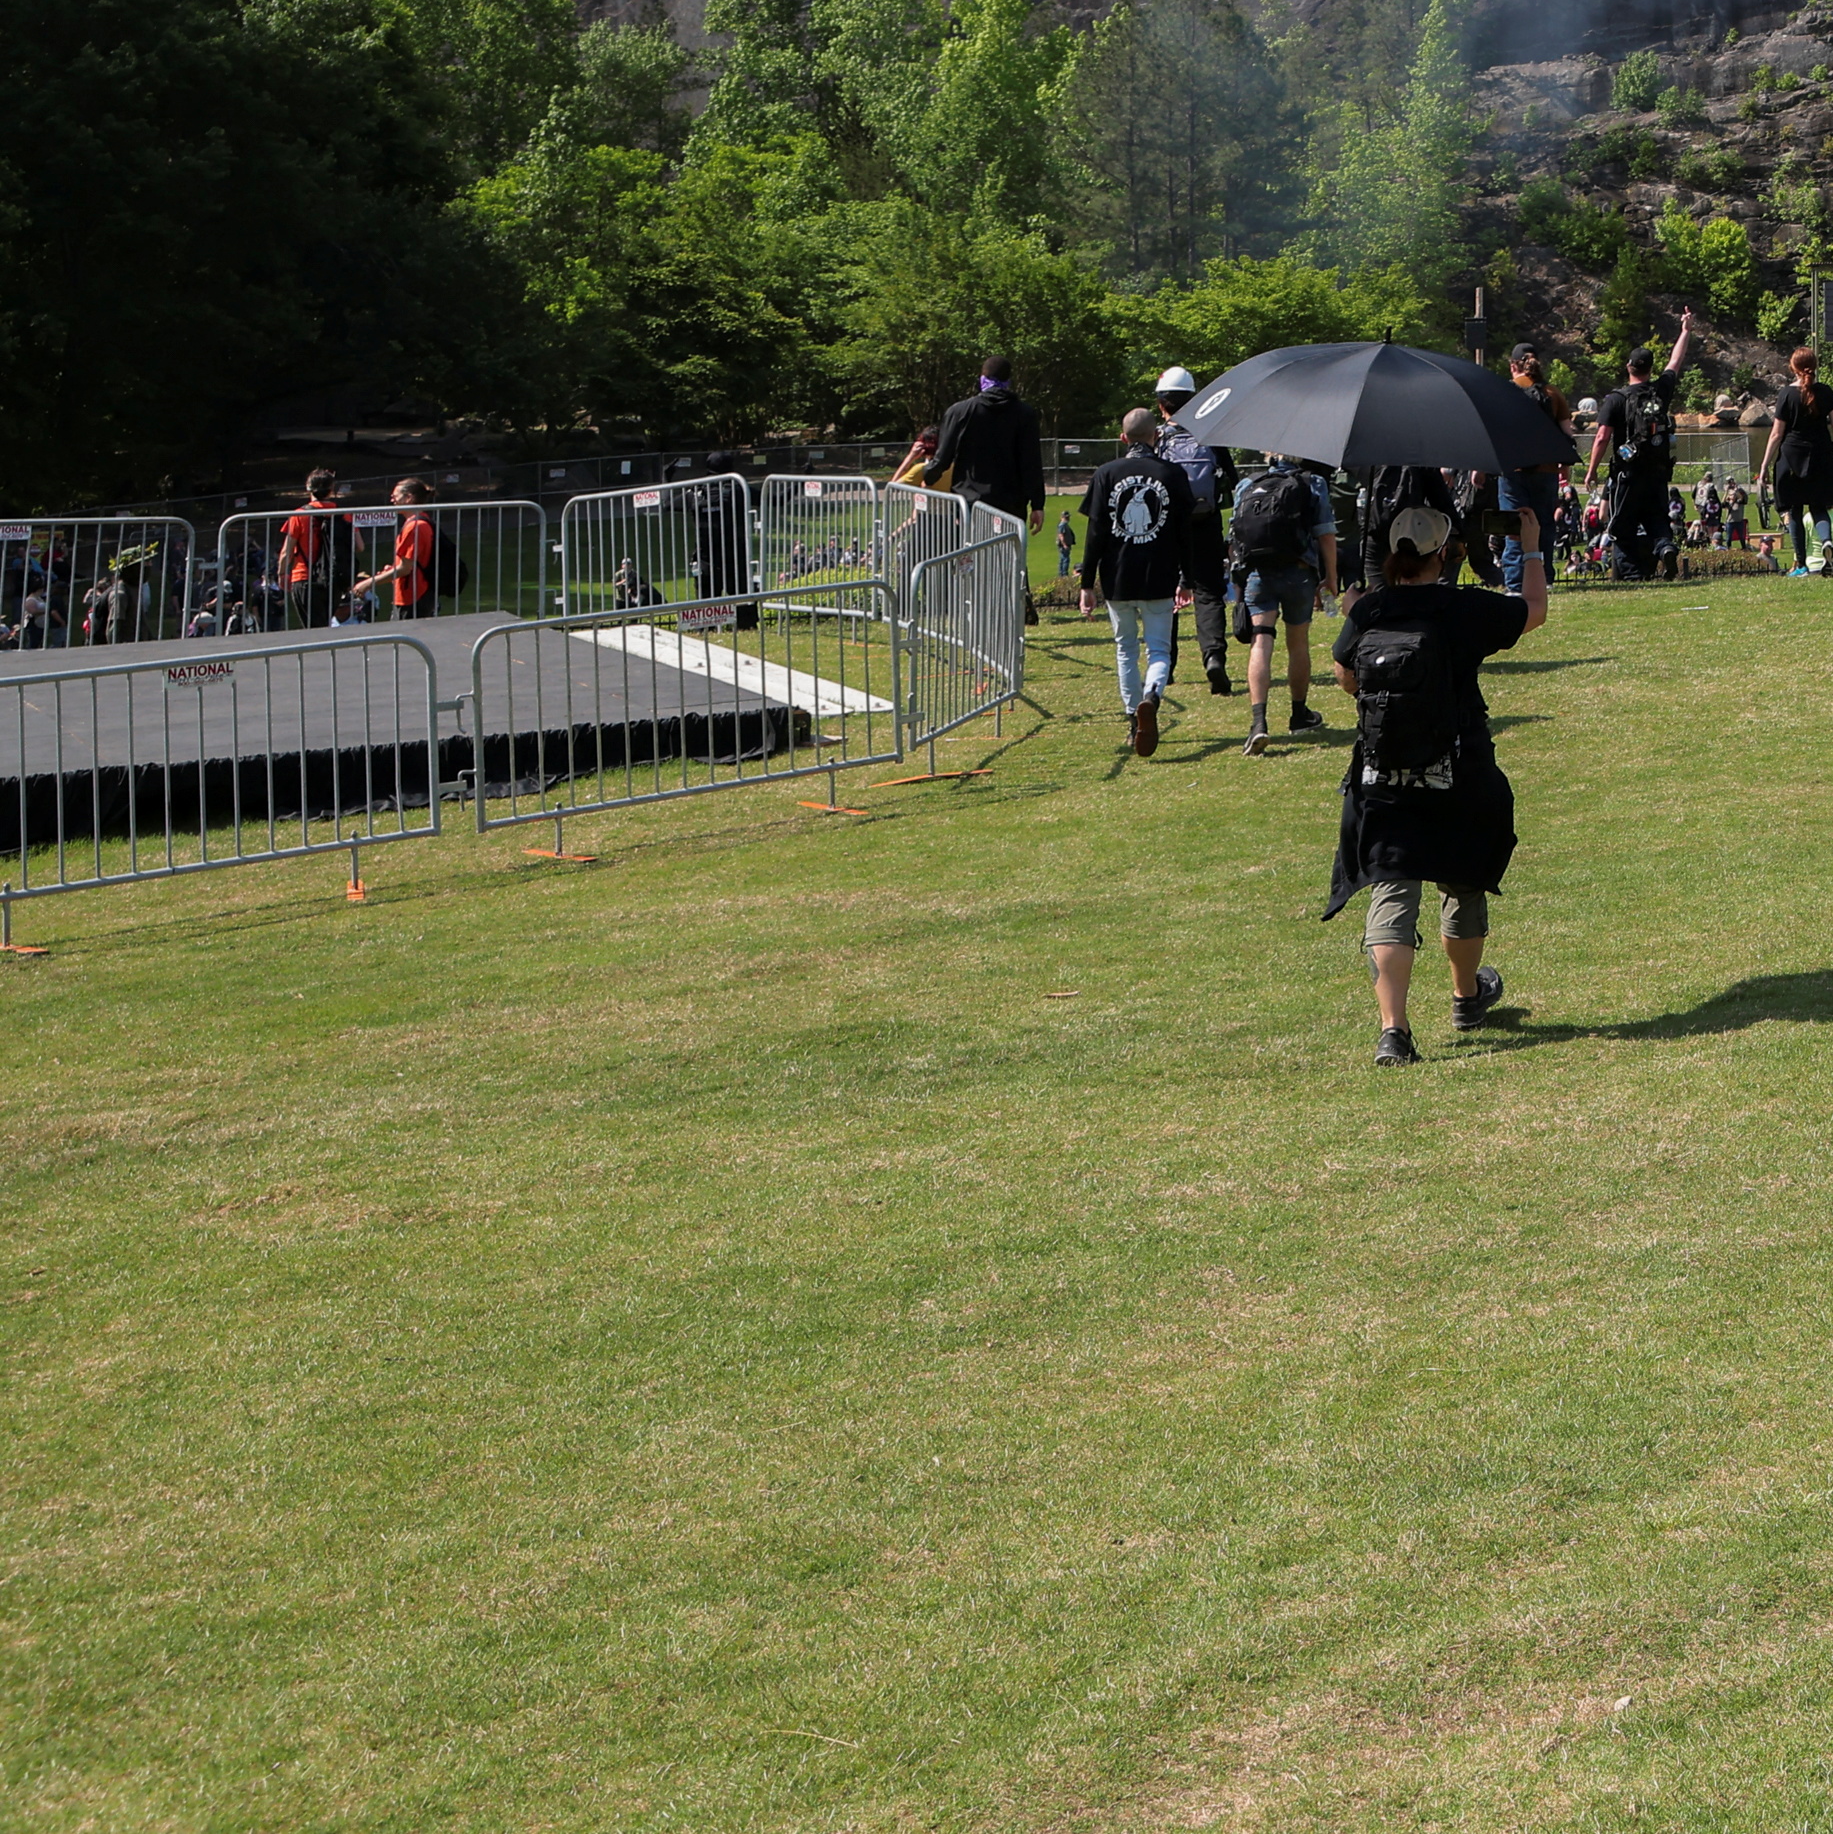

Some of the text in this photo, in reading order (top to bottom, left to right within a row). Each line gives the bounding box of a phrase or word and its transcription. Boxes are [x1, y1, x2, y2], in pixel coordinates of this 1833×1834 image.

[1108, 475, 1170, 507] RACIST LIVES
[355, 512, 396, 520] NATIONAL
[1133, 509, 1169, 544] MATTER
[681, 604, 734, 620] NATIONAL
[168, 662, 233, 680] NATIONAL
